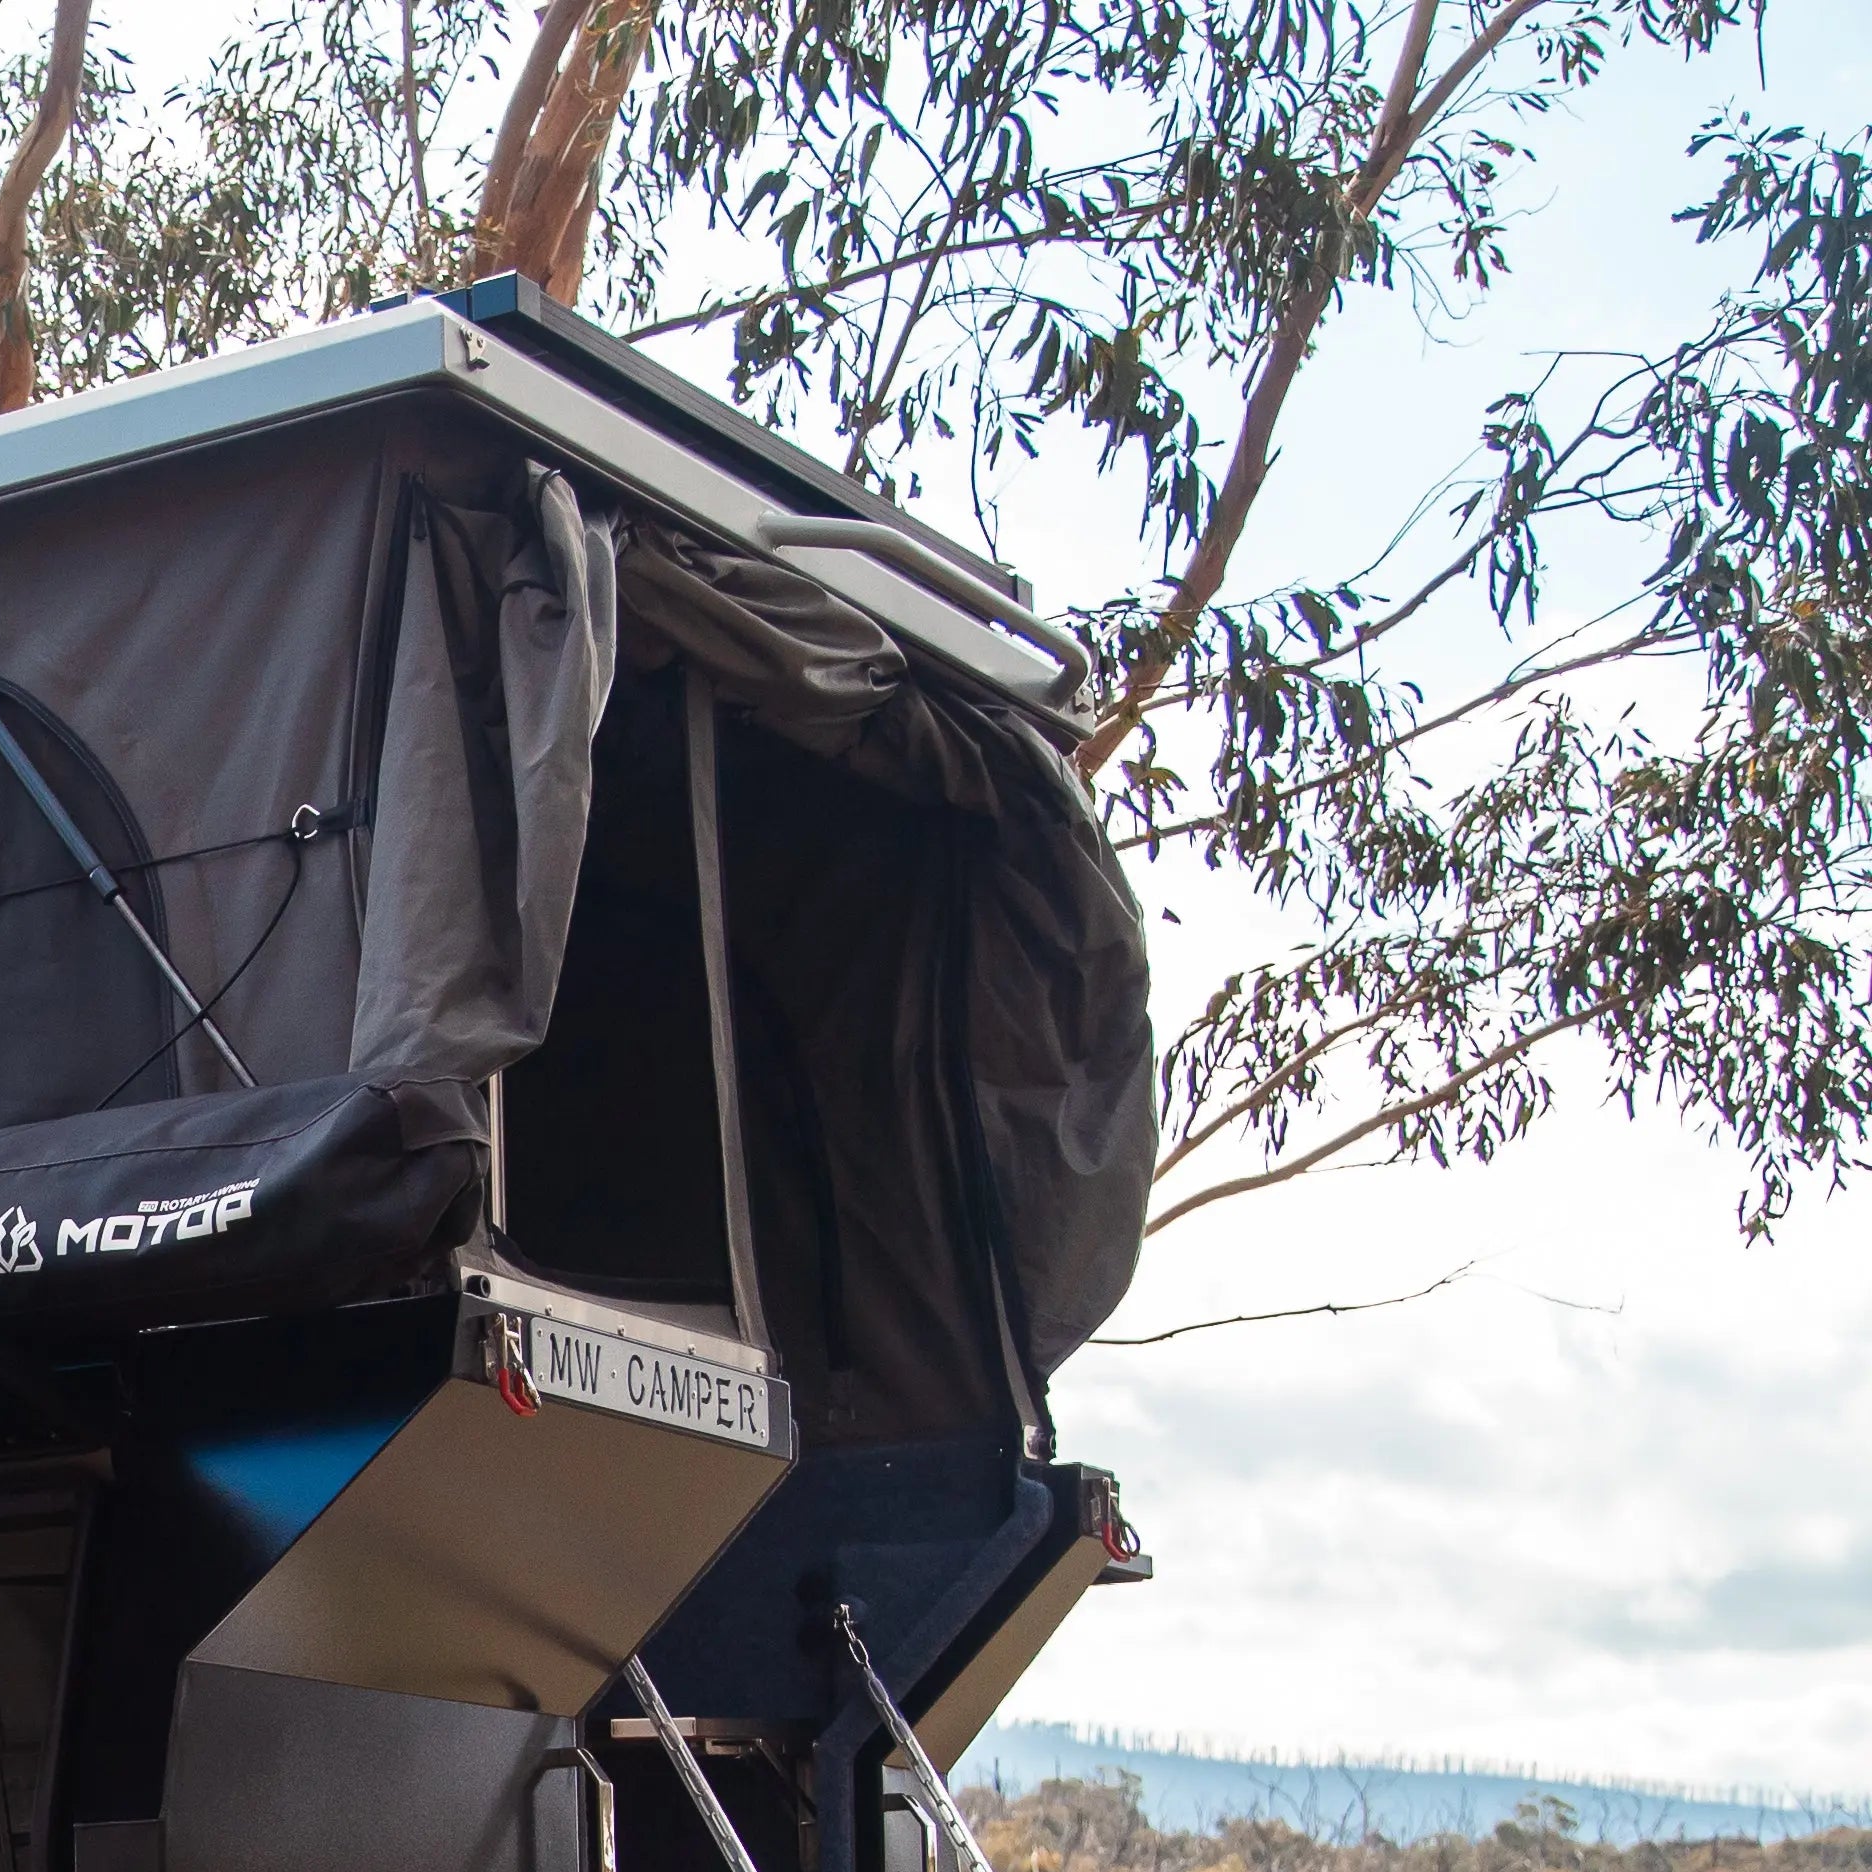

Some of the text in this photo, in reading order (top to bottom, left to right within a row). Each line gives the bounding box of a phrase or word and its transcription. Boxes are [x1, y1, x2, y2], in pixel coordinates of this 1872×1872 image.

[56, 1189, 255, 1256] MOTOP
[159, 1192, 210, 1212] ROTARY
[209, 1177, 261, 1199] AWNING
[549, 1332, 758, 1435] MW CAMPER
